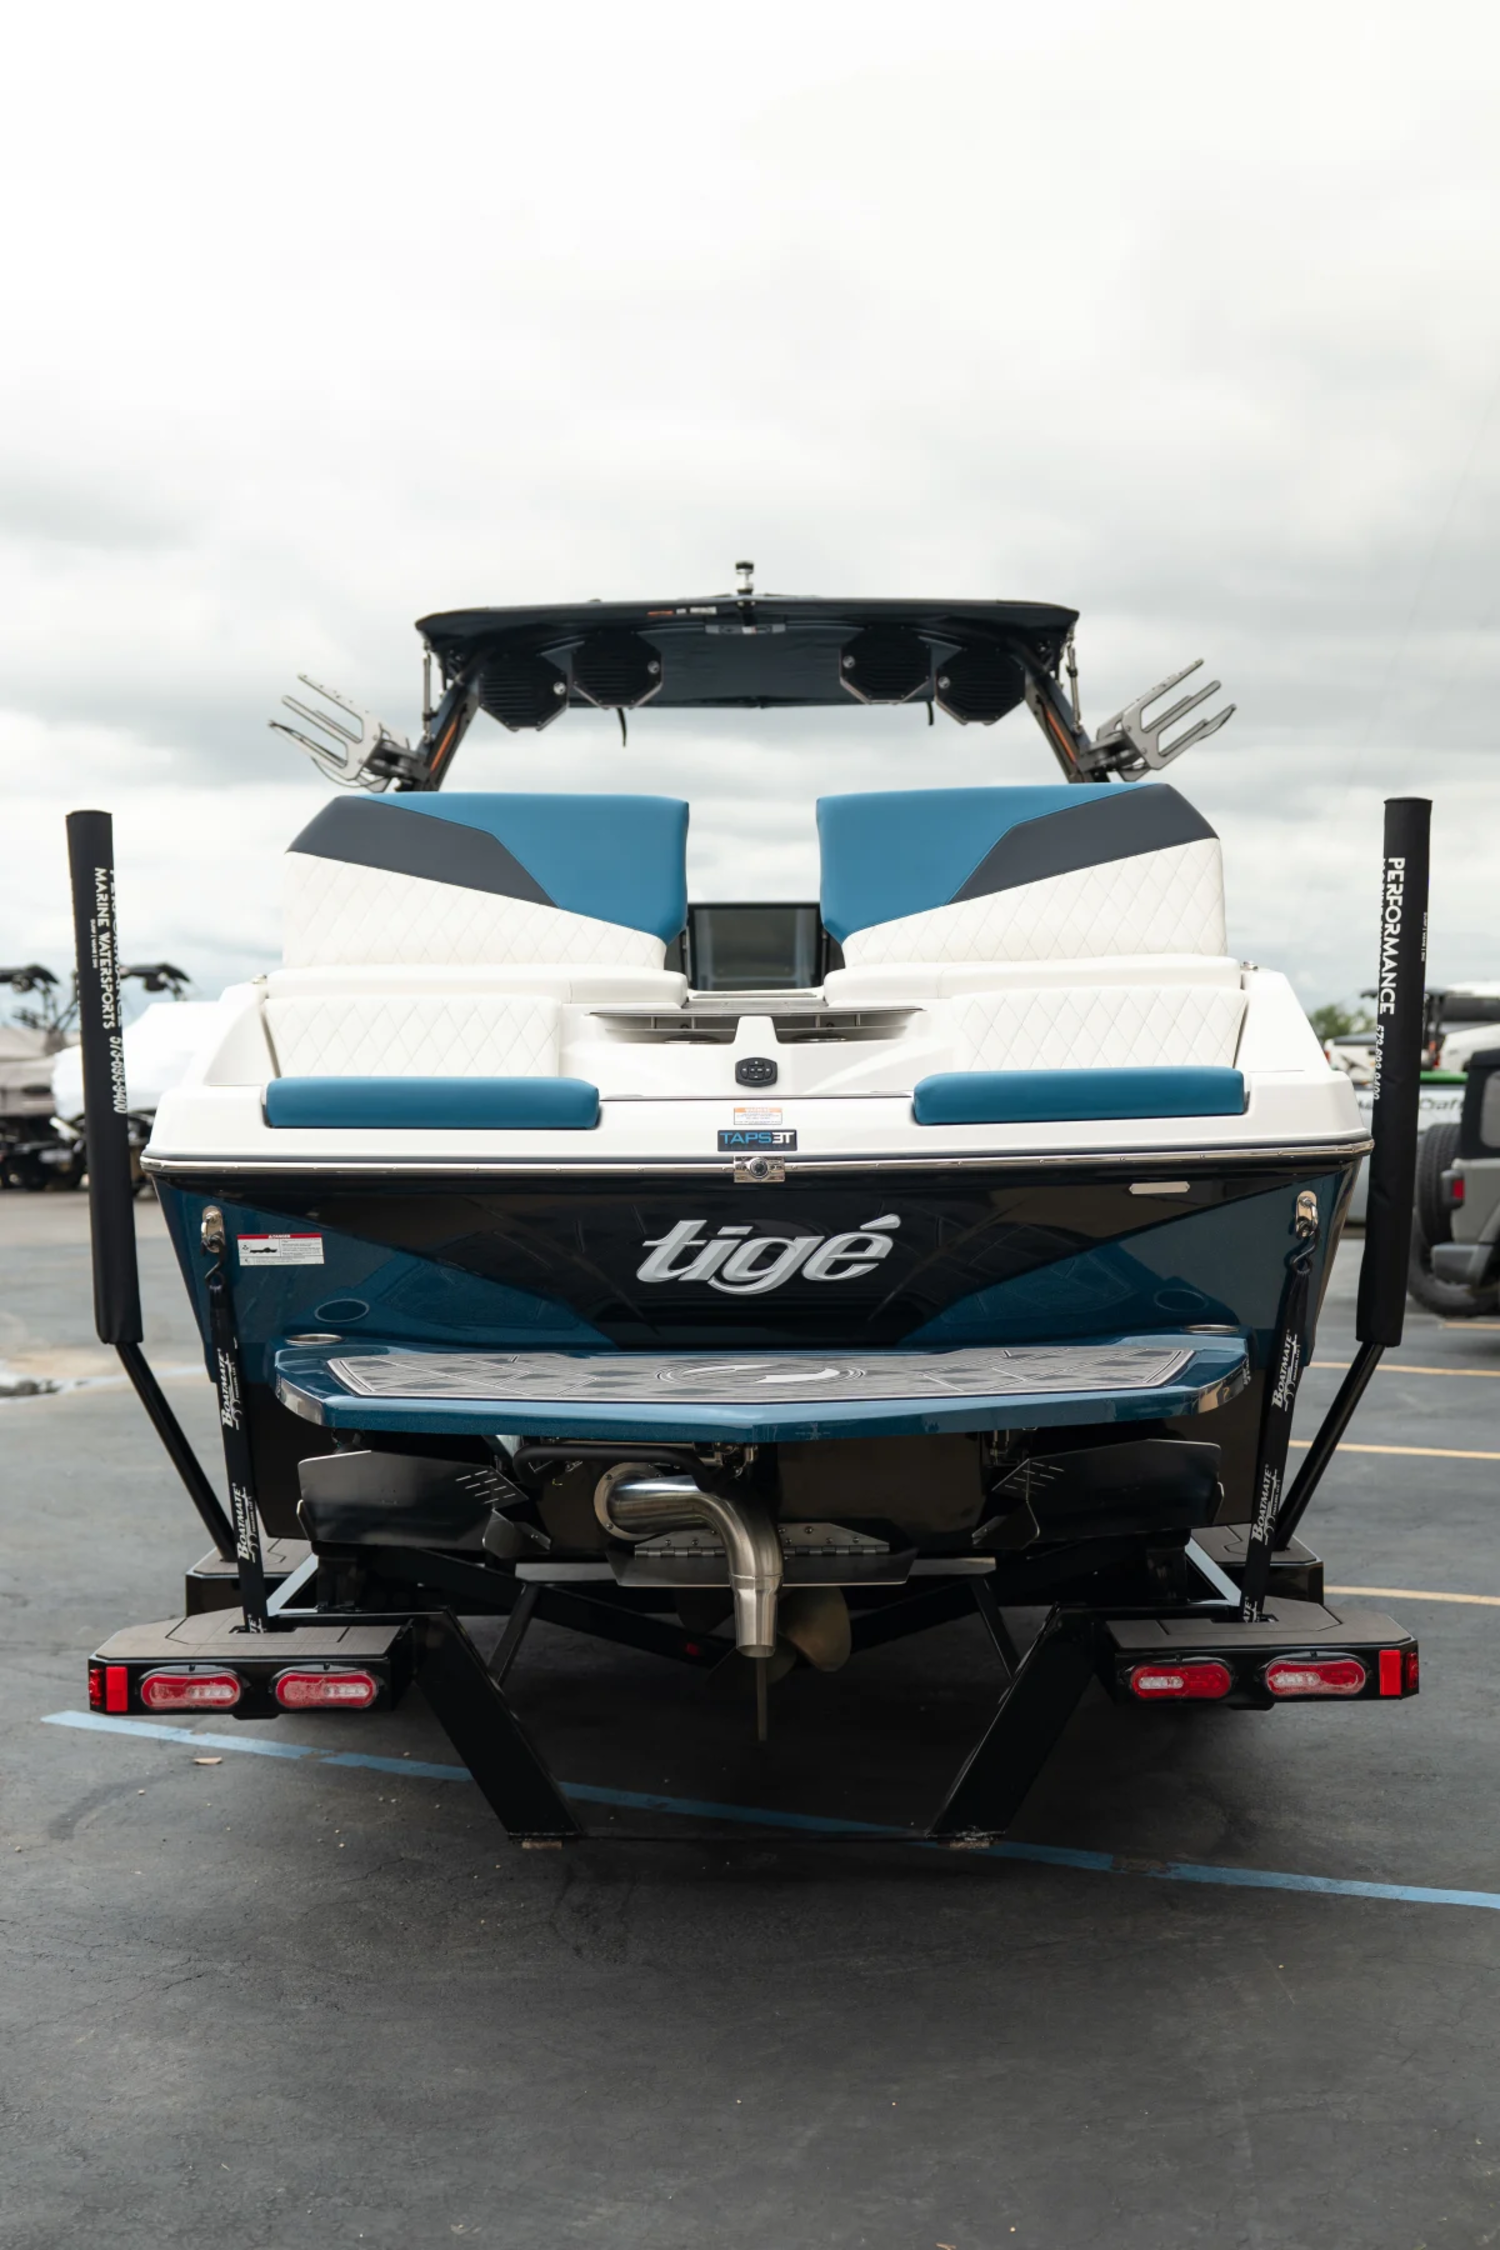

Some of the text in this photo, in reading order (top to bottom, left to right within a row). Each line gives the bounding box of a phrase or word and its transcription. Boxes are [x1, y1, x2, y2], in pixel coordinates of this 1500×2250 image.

[94, 867, 115, 1029] MARINE WATERSPORTS
[1380, 857, 1405, 1015] PERFORMANCE
[636, 1213, 901, 1296] tigé
[217, 1351, 233, 1428] BOATMATE
[1271, 1333, 1292, 1409] BOATMATE
[234, 1487, 249, 1561] BOATMATE
[1251, 1468, 1273, 1542] BOATMATE
